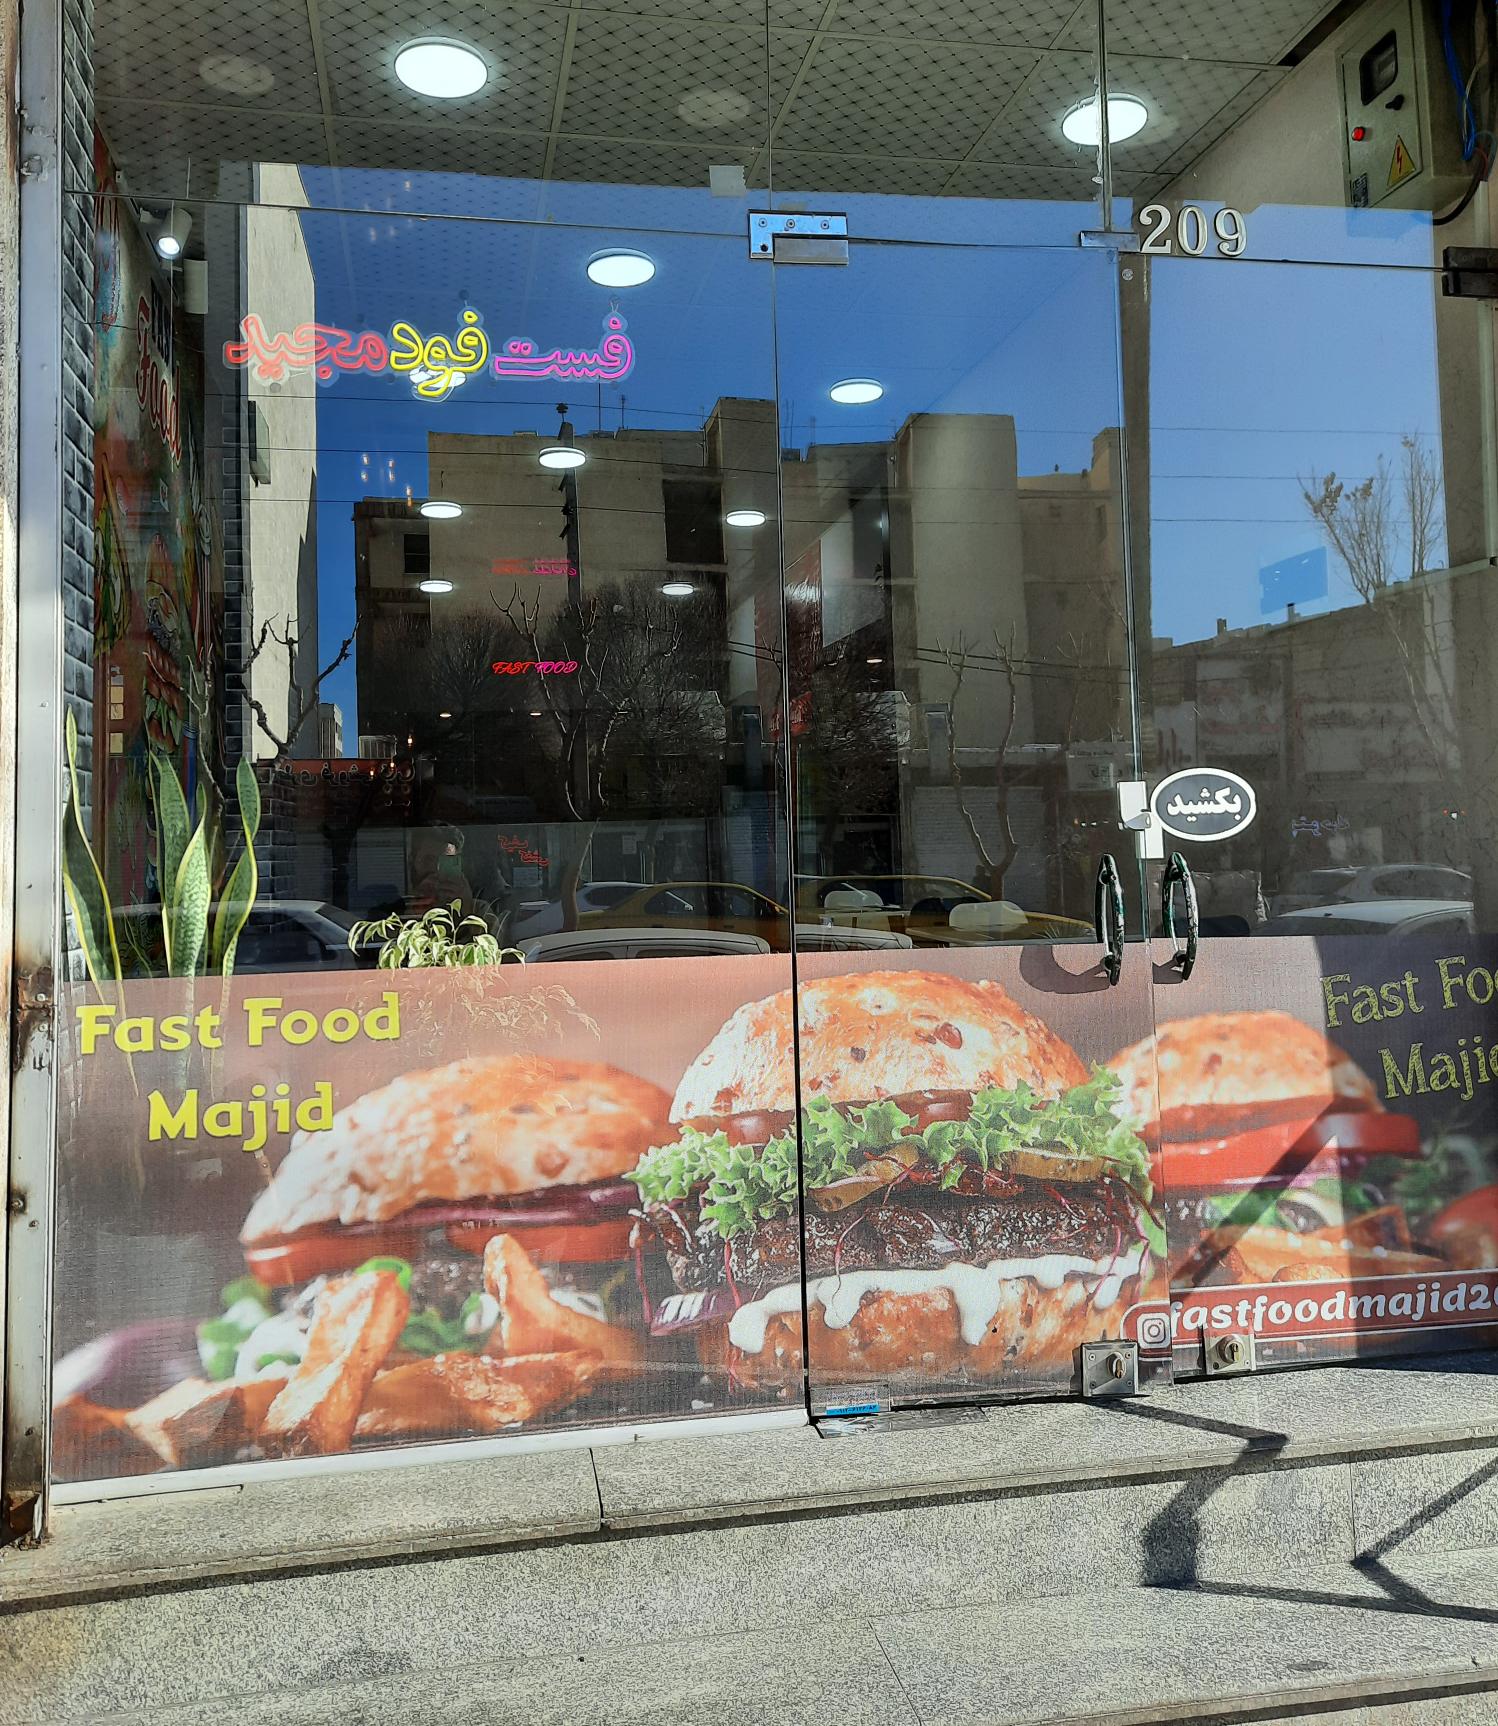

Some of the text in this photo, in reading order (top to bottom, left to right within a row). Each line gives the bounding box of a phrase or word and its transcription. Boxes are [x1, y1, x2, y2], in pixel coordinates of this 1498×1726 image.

[1139, 204, 1247, 257] 209
[225, 310, 634, 397] فست فود مجید
[492, 661, 578, 675] FAST FOOD
[1166, 786, 1242, 823] بکشید
[1320, 955, 1498, 1028] Fast Fo
[76, 991, 401, 1055] Fast Food
[148, 1081, 334, 1152] Majid
[1171, 1282, 1498, 1338] fastfoodmajid2
